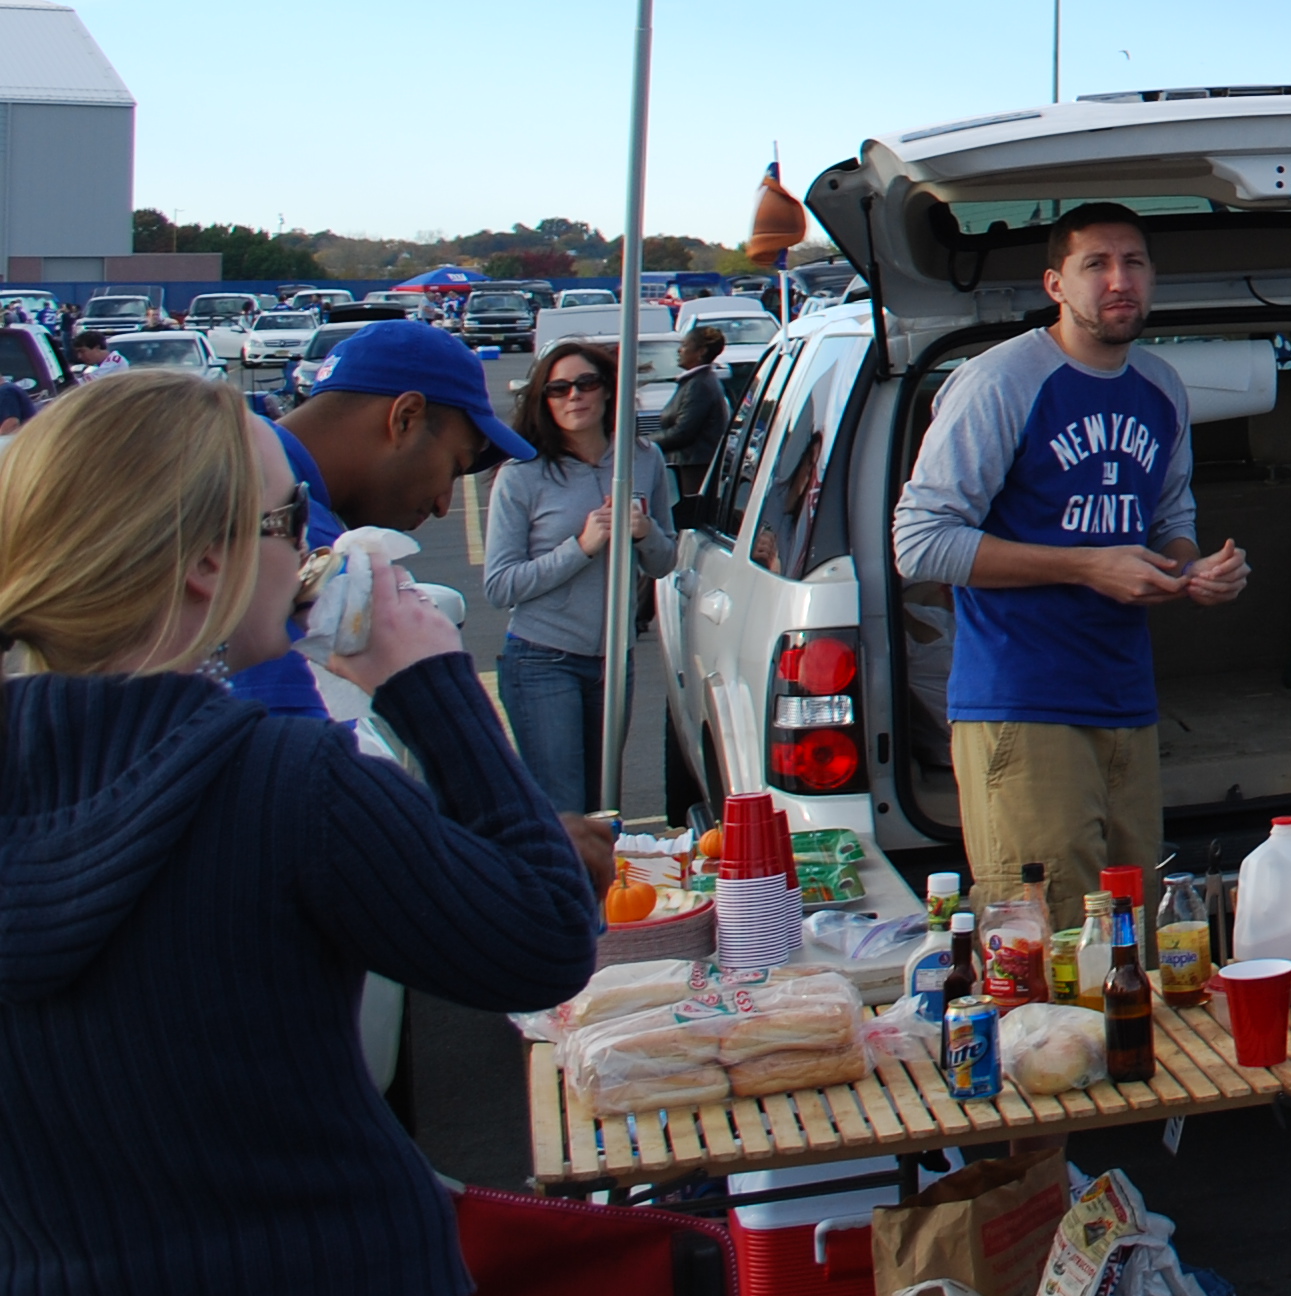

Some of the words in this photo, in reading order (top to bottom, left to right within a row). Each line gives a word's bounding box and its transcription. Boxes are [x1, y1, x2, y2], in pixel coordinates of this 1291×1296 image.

[1049, 413, 1107, 472] NEW
[1111, 413, 1160, 474] YORK
[1061, 493, 1144, 533] GIANTS
